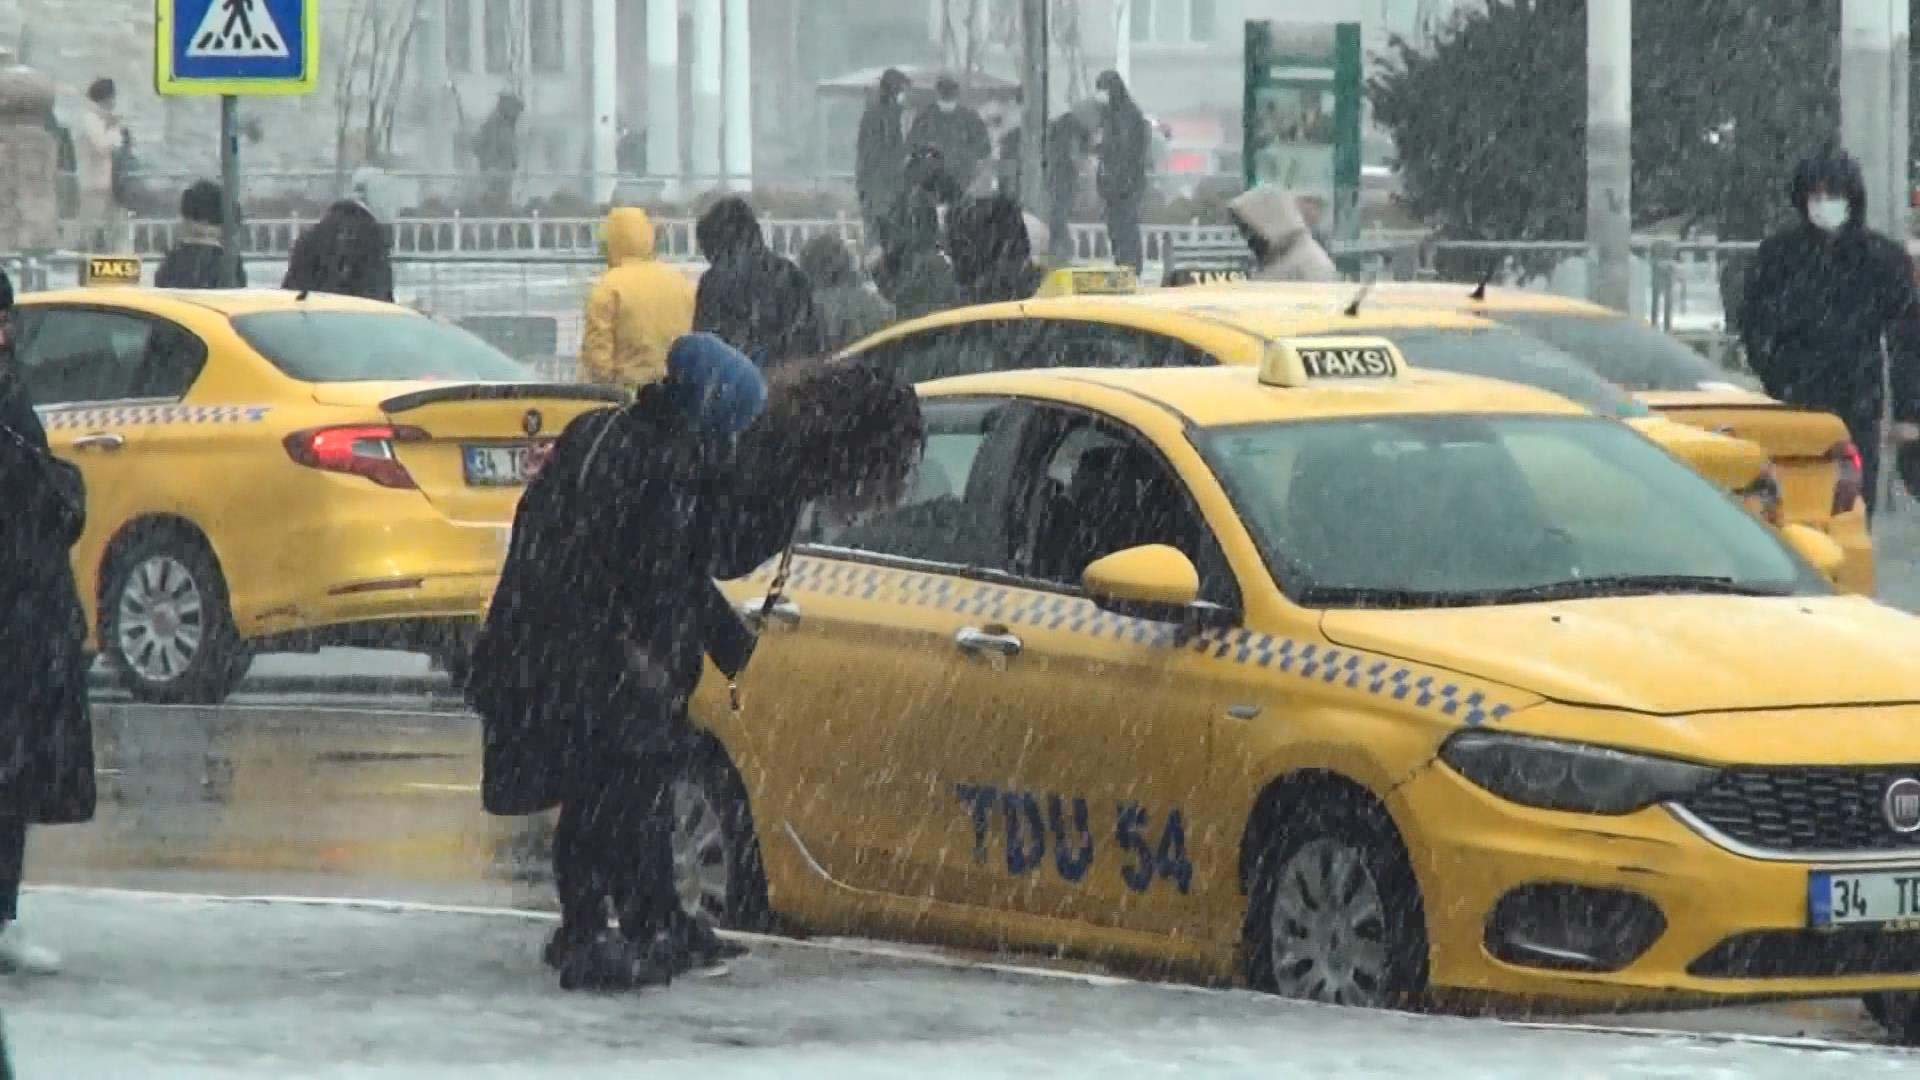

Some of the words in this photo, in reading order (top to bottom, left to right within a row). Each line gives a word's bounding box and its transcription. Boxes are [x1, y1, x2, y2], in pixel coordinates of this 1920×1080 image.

[1302, 350, 1394, 375] TAKSI
[955, 783, 1093, 882] TDU
[1116, 800, 1193, 895] 54
[1833, 878, 1867, 917] 34
